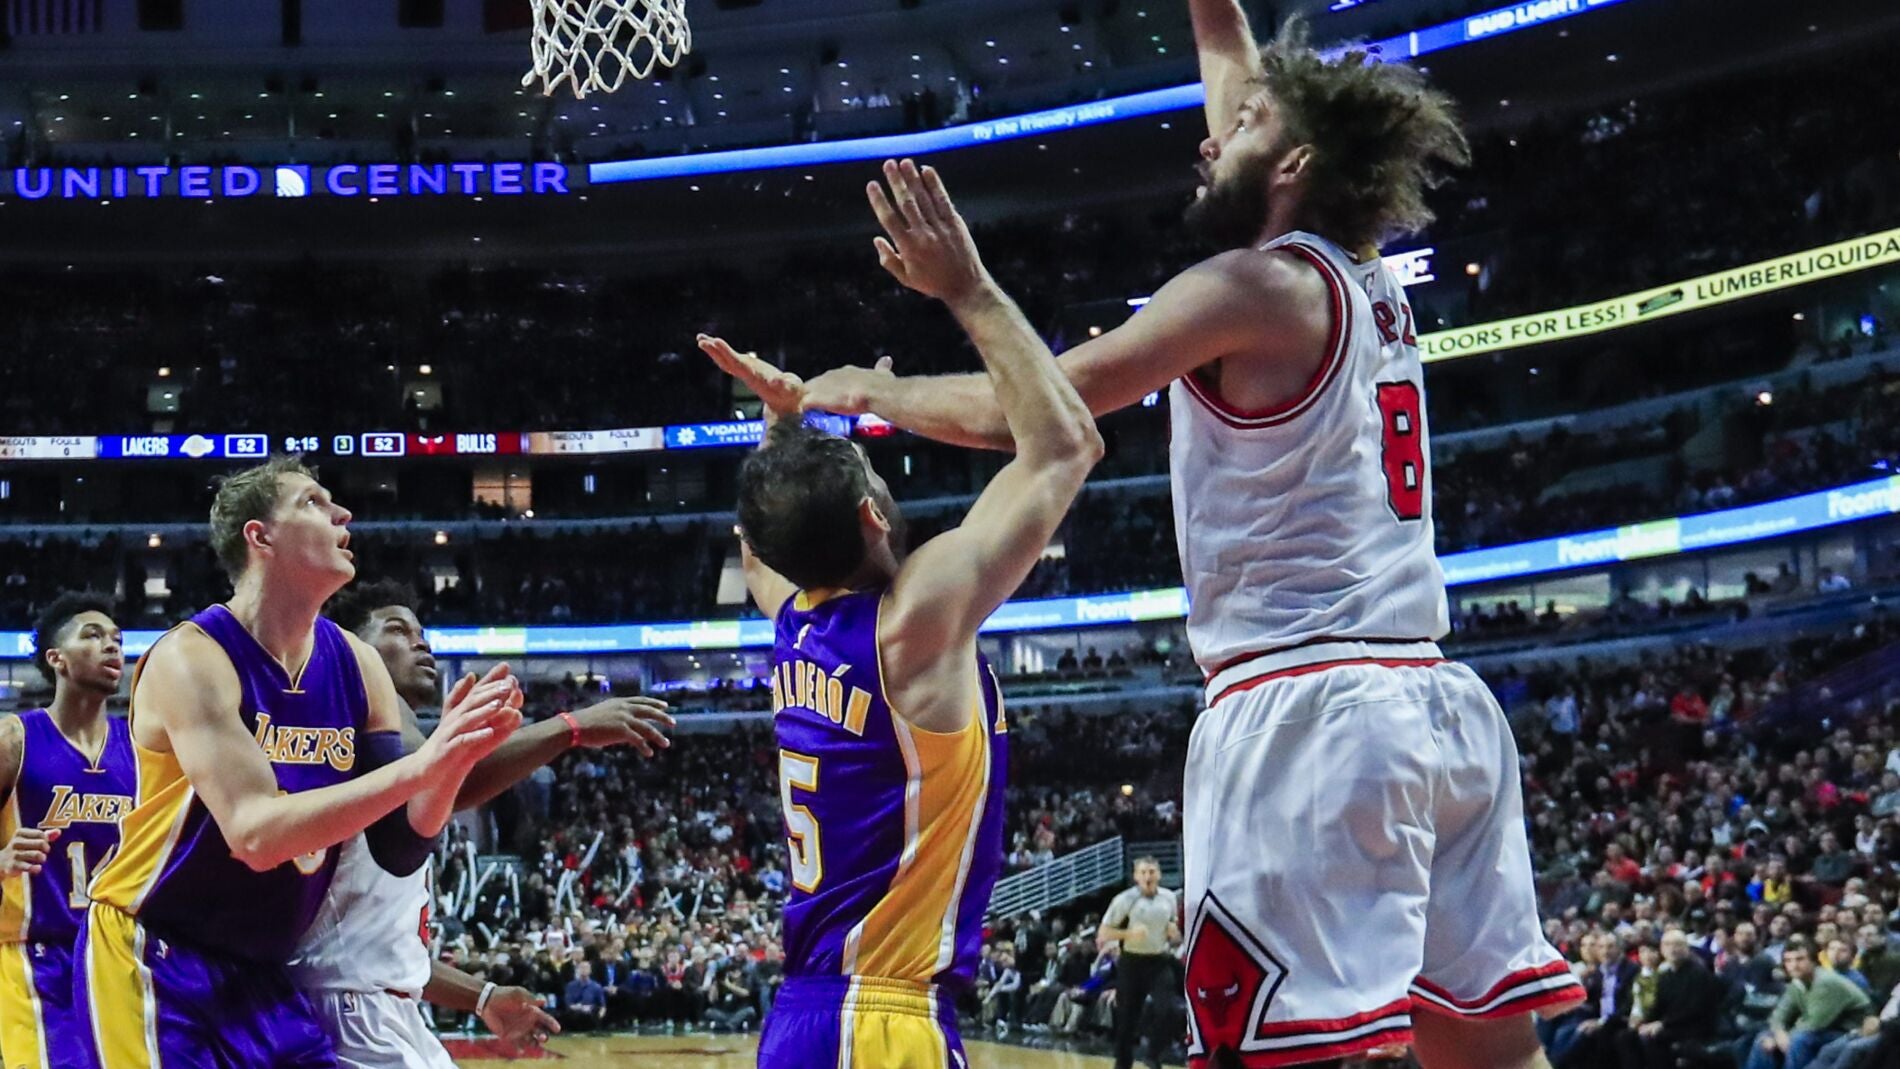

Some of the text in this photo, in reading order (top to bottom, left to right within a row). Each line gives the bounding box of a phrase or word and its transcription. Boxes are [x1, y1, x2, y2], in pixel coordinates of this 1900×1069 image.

[1467, 0, 1580, 37] BUD LIGHT
[994, 121, 1019, 136] the
[1019, 111, 1077, 132] friendly
[14, 162, 569, 200] UNITED CENTER
[1696, 237, 1900, 300] LUMBERLIQUIDA
[1511, 318, 1557, 340] FOR
[1566, 304, 1625, 331] LESS!
[285, 436, 319, 451] 9:15
[373, 436, 394, 451] 52
[456, 434, 496, 453] BULLS
[702, 421, 763, 437] VIDANTA
[121, 437, 169, 456] LAKERS
[236, 438, 256, 453] 52
[339, 440, 348, 450] 3
[1376, 380, 1425, 522] 8
[772, 660, 872, 736] ALDERÓN
[37, 785, 133, 829] LAKER
[779, 749, 823, 894] 5
